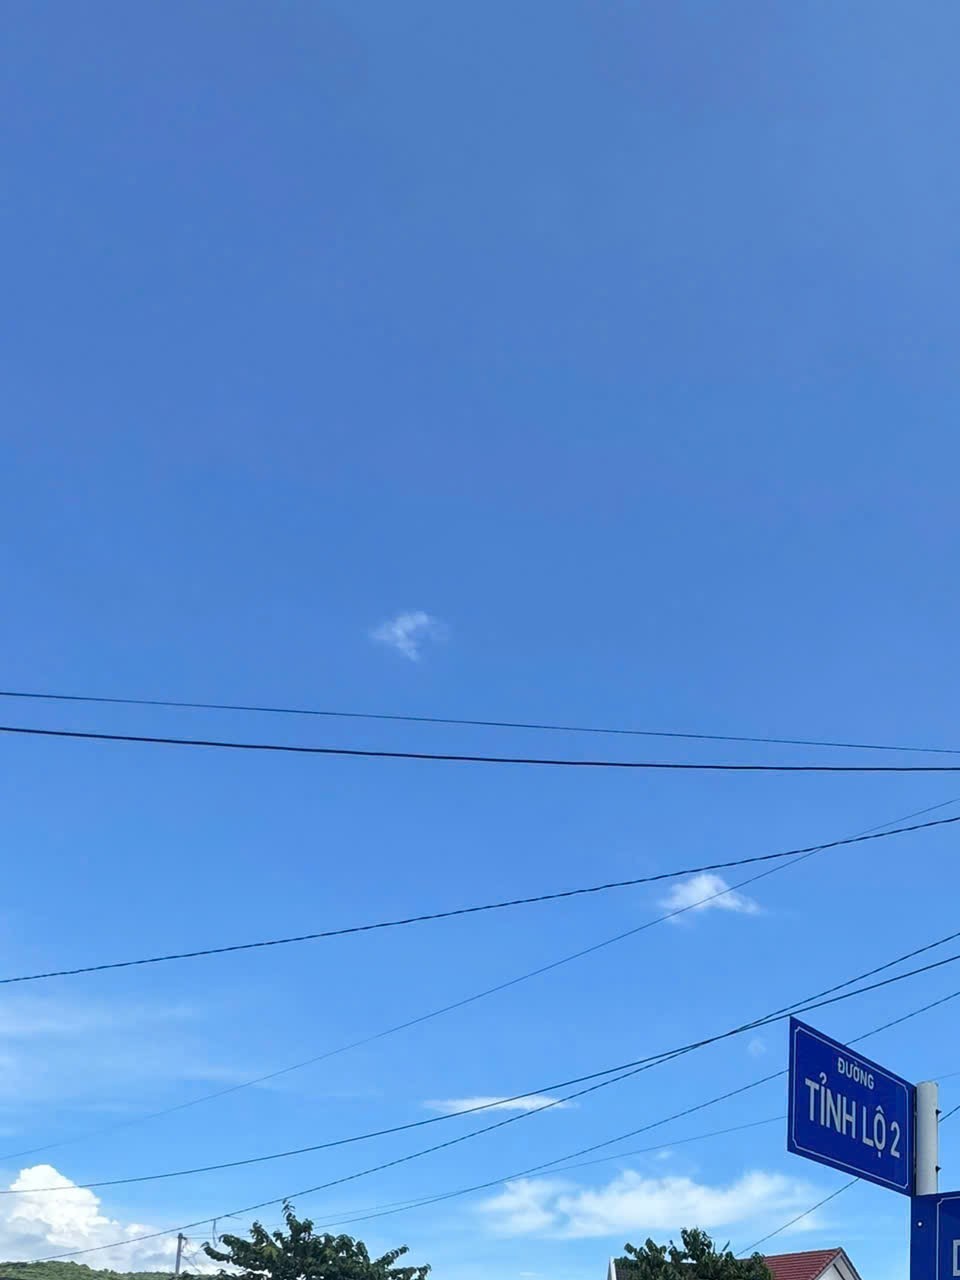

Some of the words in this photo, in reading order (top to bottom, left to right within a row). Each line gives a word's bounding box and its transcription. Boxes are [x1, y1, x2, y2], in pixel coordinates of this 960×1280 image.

[837, 1056, 875, 1091] ĐƯỜNG
[805, 1071, 857, 1140] TỈNH
[862, 1105, 887, 1158] LỘ
[890, 1120, 901, 1159] 2
